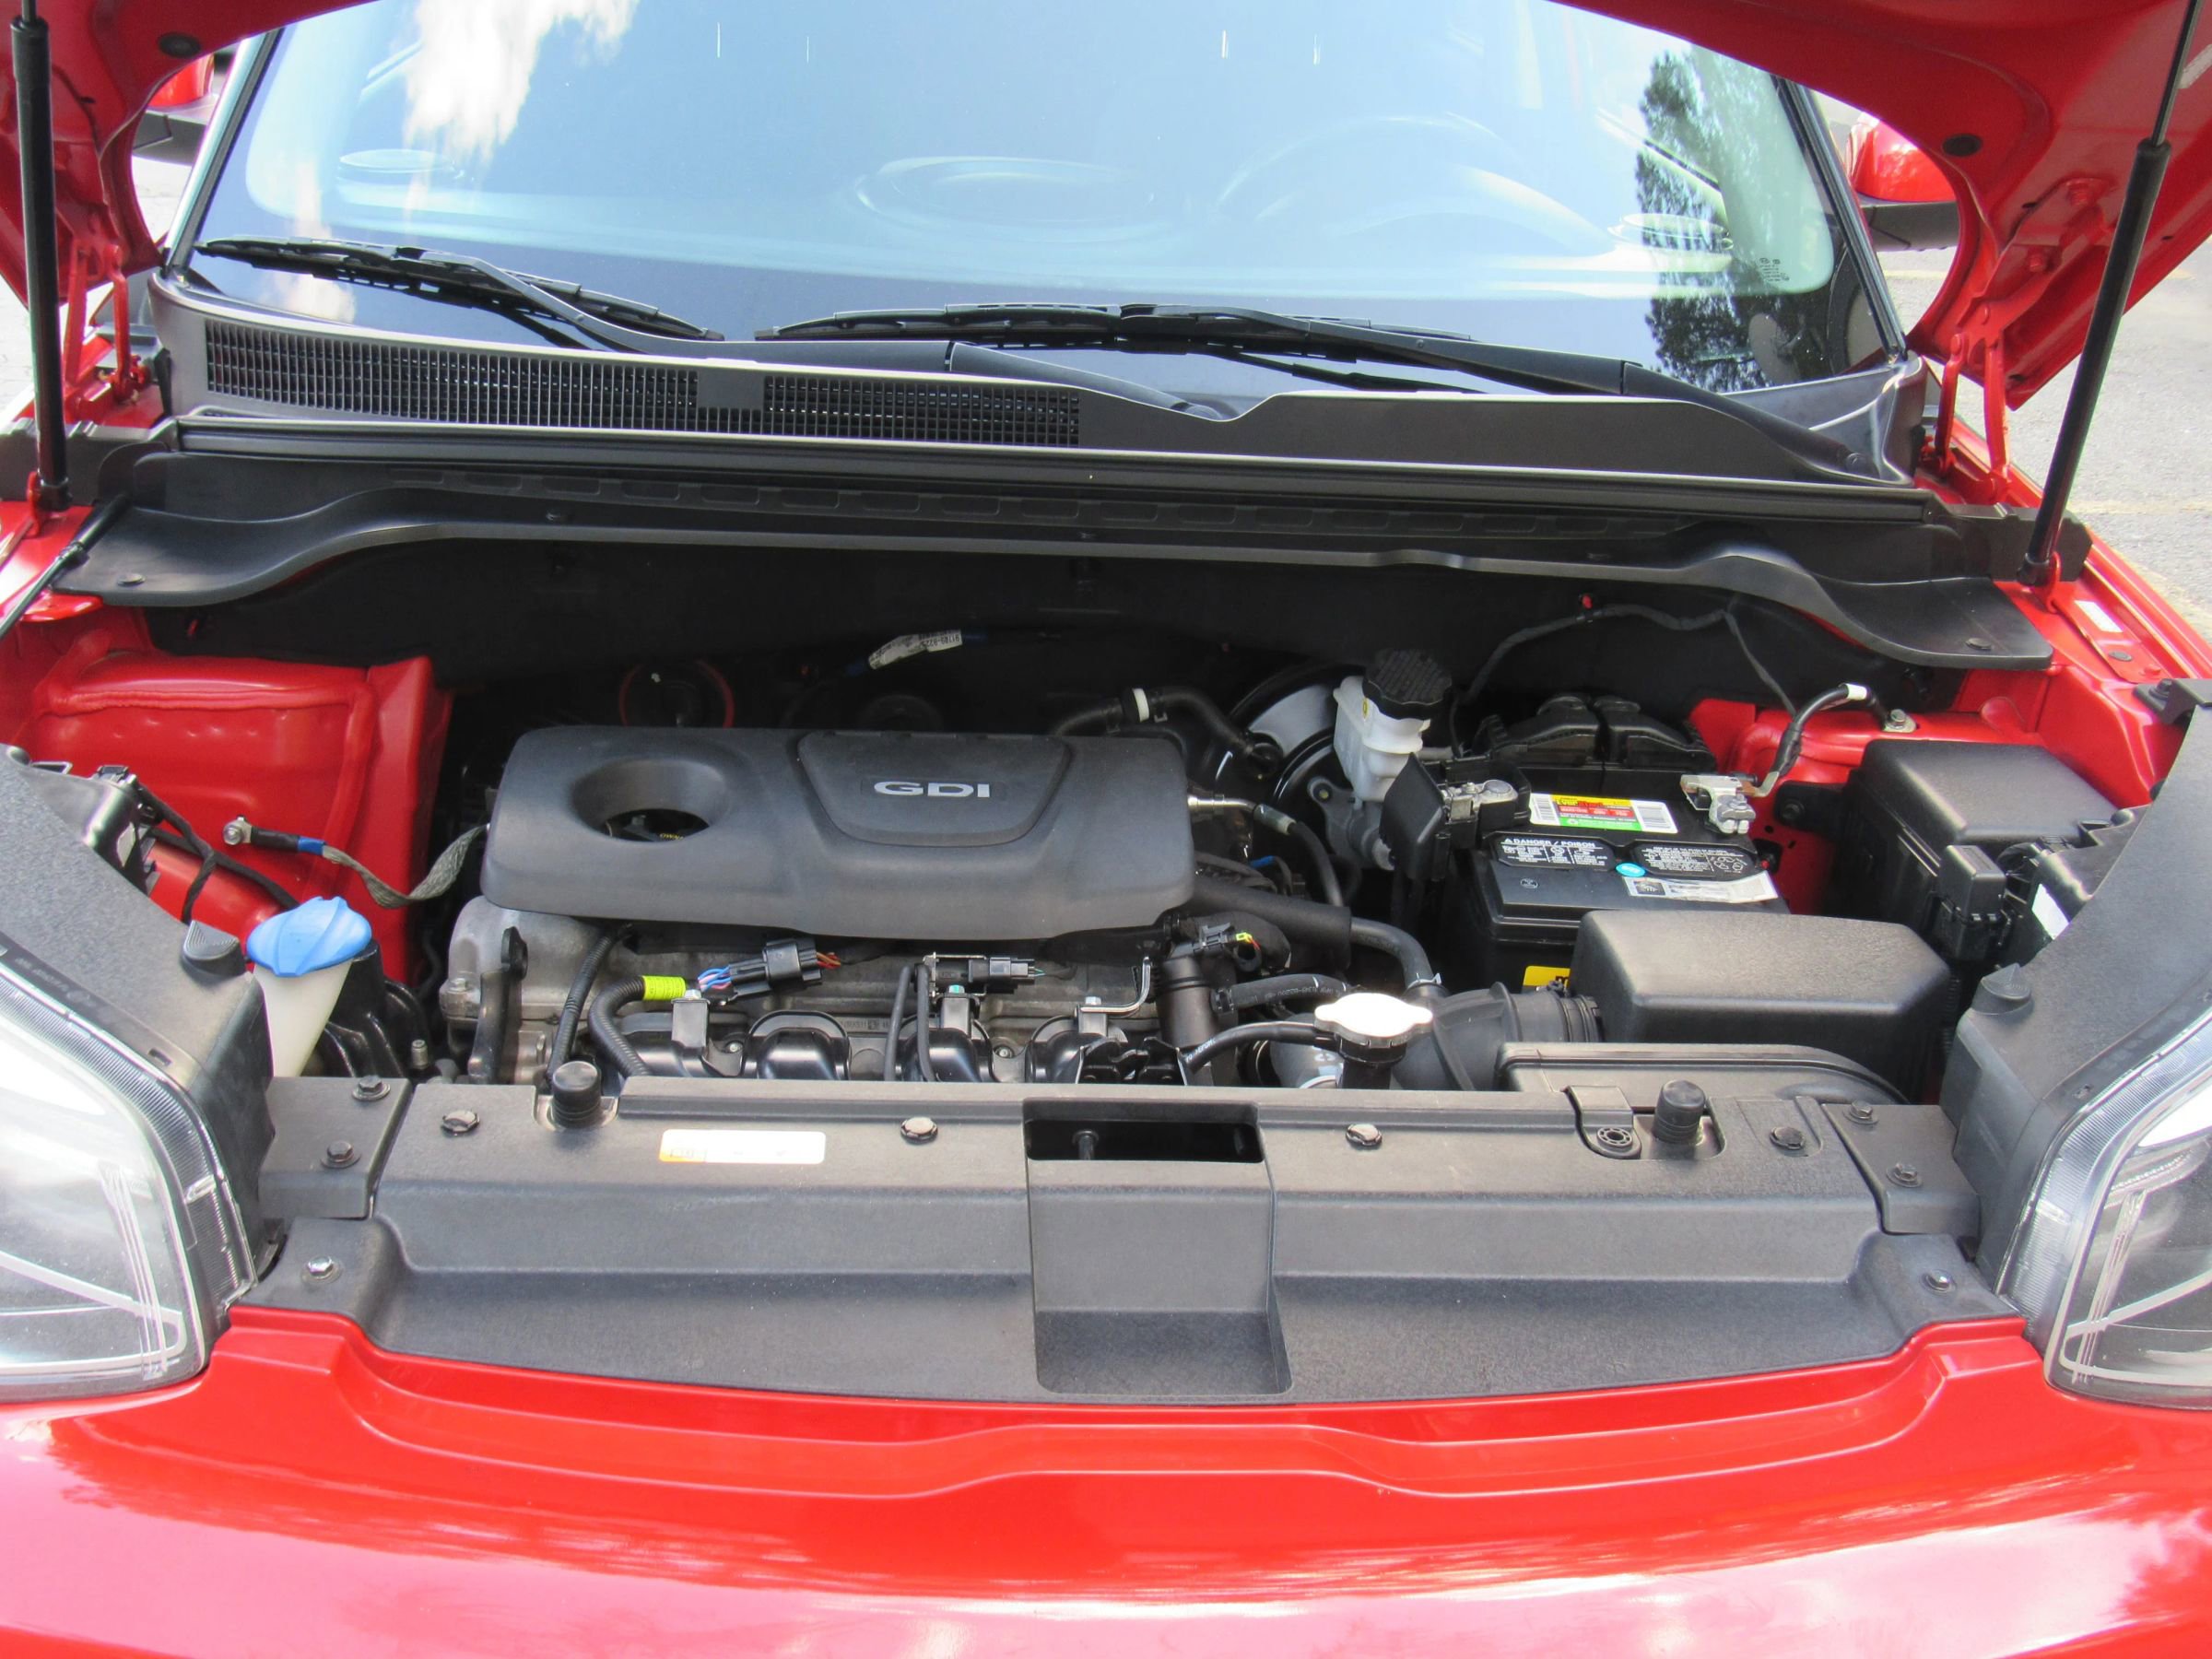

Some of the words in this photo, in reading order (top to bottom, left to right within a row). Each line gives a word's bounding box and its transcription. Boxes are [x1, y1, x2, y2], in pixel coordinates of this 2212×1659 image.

[874, 781, 991, 798] GDI
[1512, 838, 1551, 846] DANGER
[1560, 840, 1595, 848] POISON
